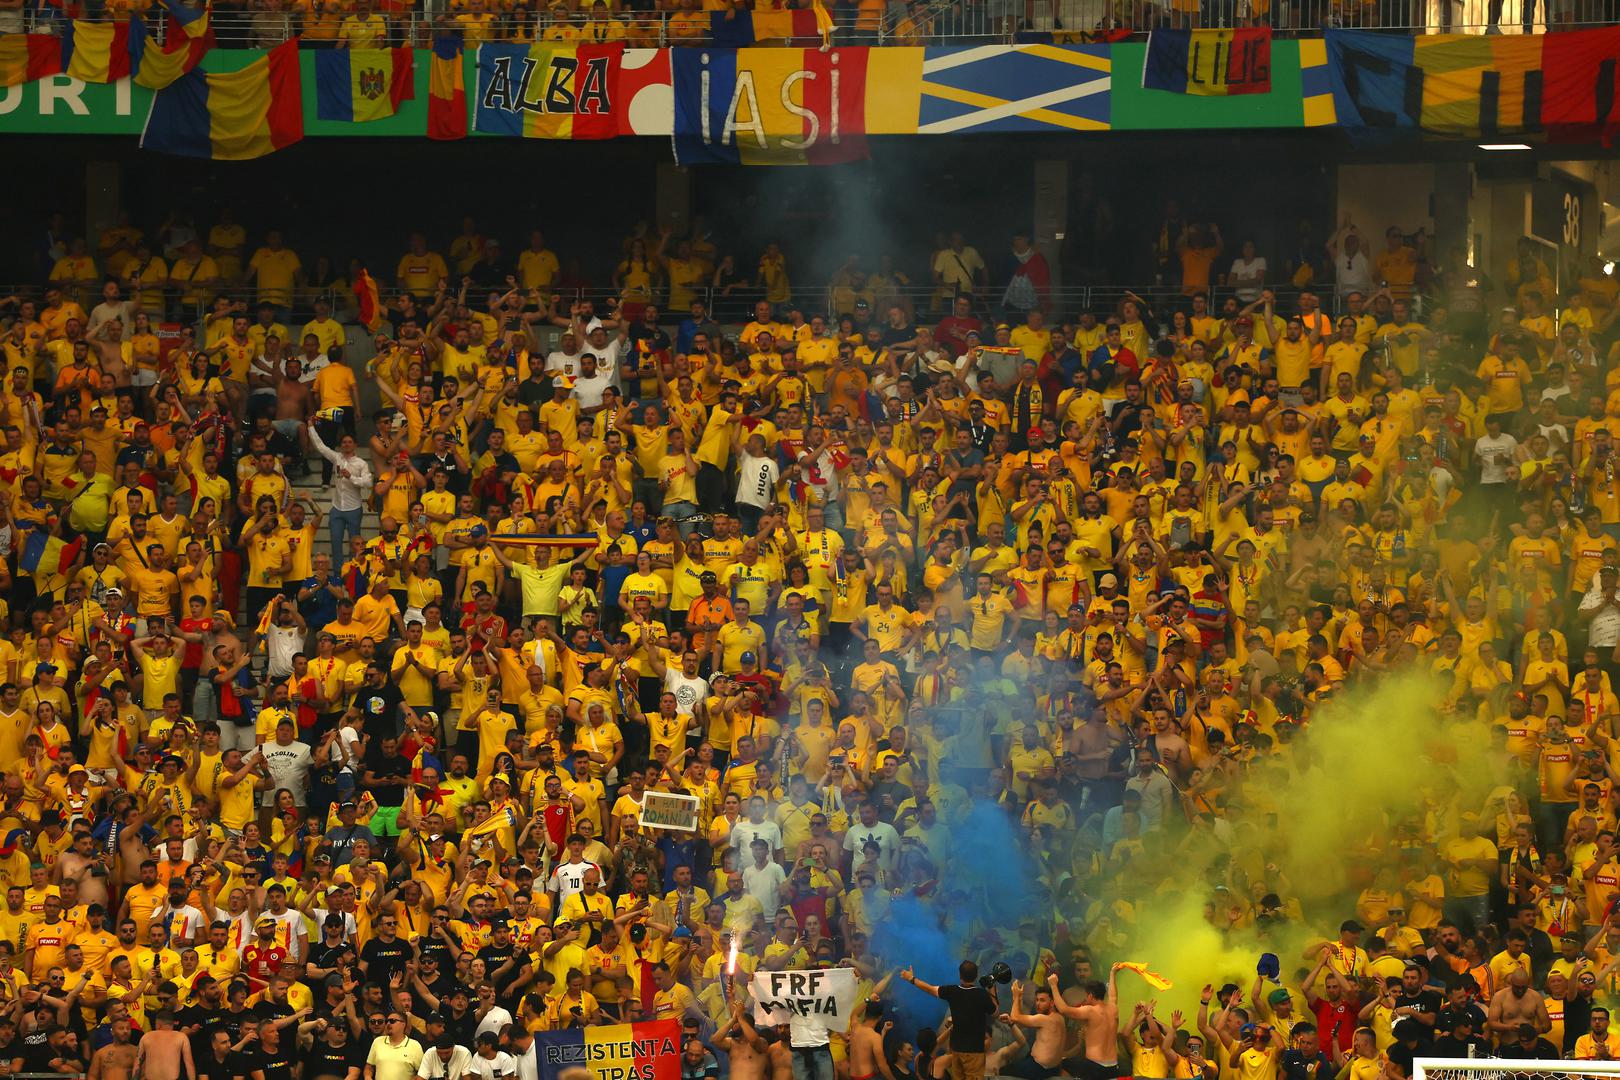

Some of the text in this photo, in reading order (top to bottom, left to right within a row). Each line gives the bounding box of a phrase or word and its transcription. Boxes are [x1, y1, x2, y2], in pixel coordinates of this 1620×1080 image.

[483, 56, 611, 114] ALBA
[1563, 192, 1580, 248] 38
[757, 464, 769, 497] HUGO
[877, 622, 889, 633] 24
[266, 751, 298, 760] GASOLINE
[173, 785, 186, 816] OMANIA
[569, 878, 579, 888] 10
[771, 972, 824, 997] FRF
